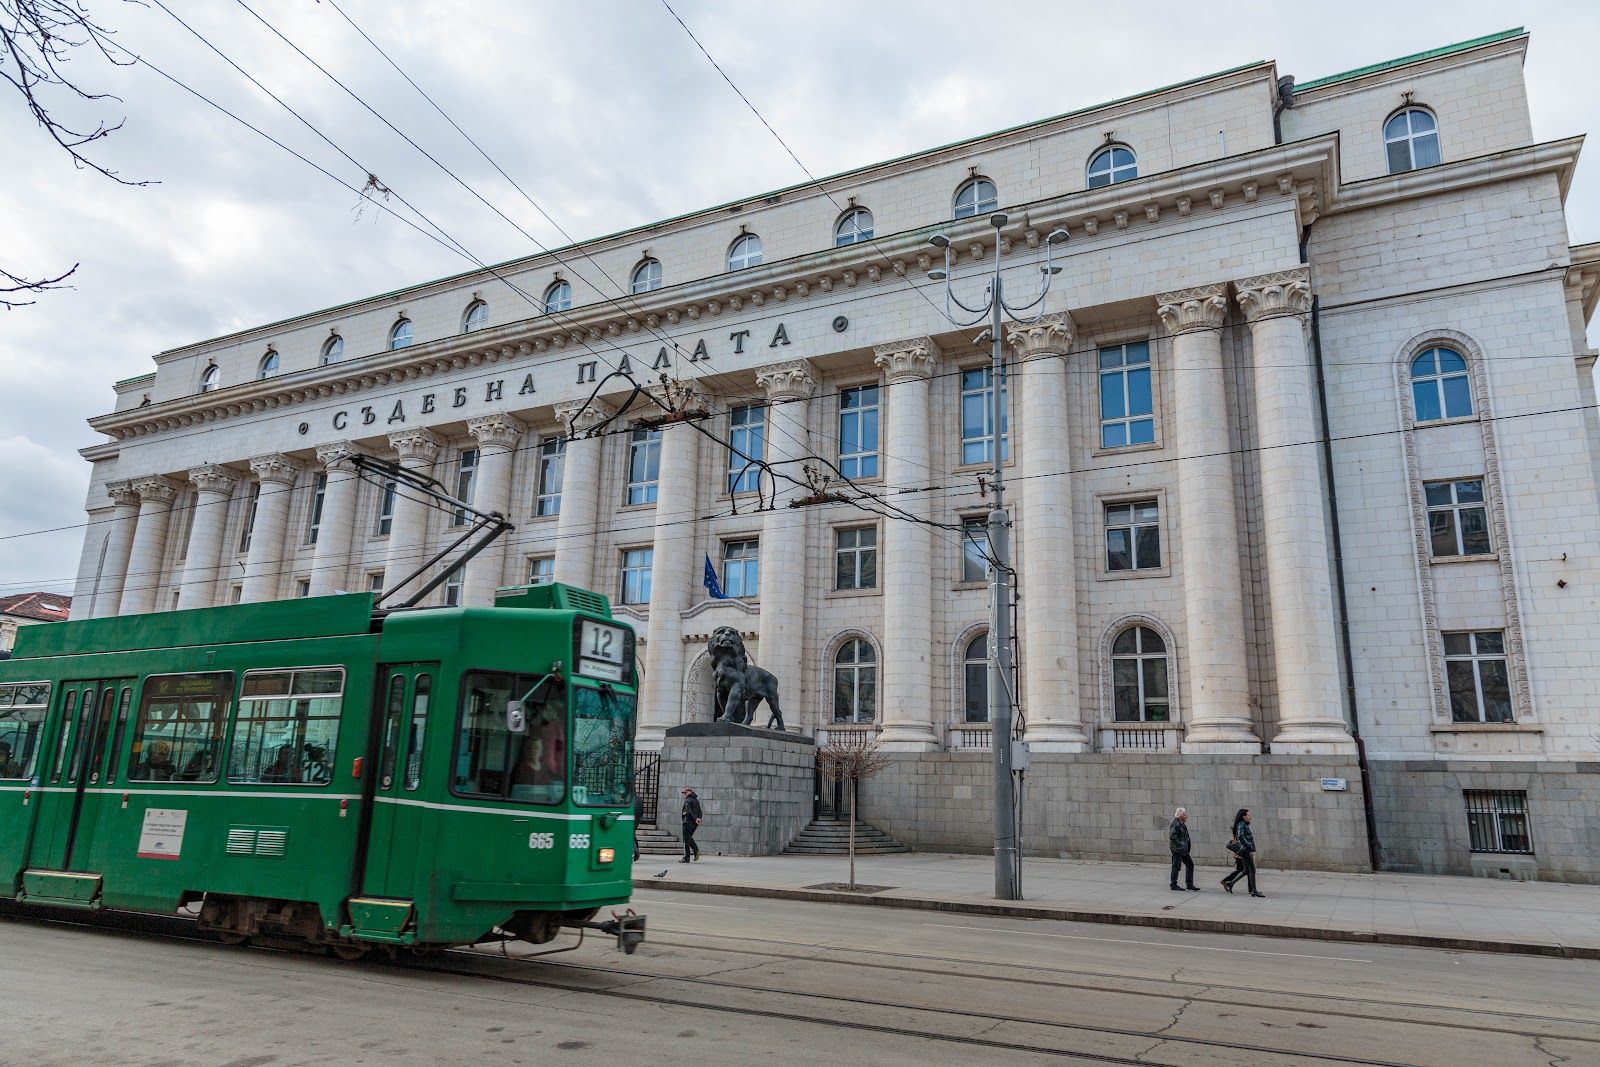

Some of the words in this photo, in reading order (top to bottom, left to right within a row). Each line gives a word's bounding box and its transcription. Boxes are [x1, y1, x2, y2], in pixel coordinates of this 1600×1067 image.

[332, 373, 536, 430] СЪДЕБНА
[576, 322, 791, 384] ПАЛАТА
[591, 627, 613, 658] 12
[304, 761, 324, 782] 12
[529, 833, 554, 849] 665
[569, 834, 590, 849] 665
